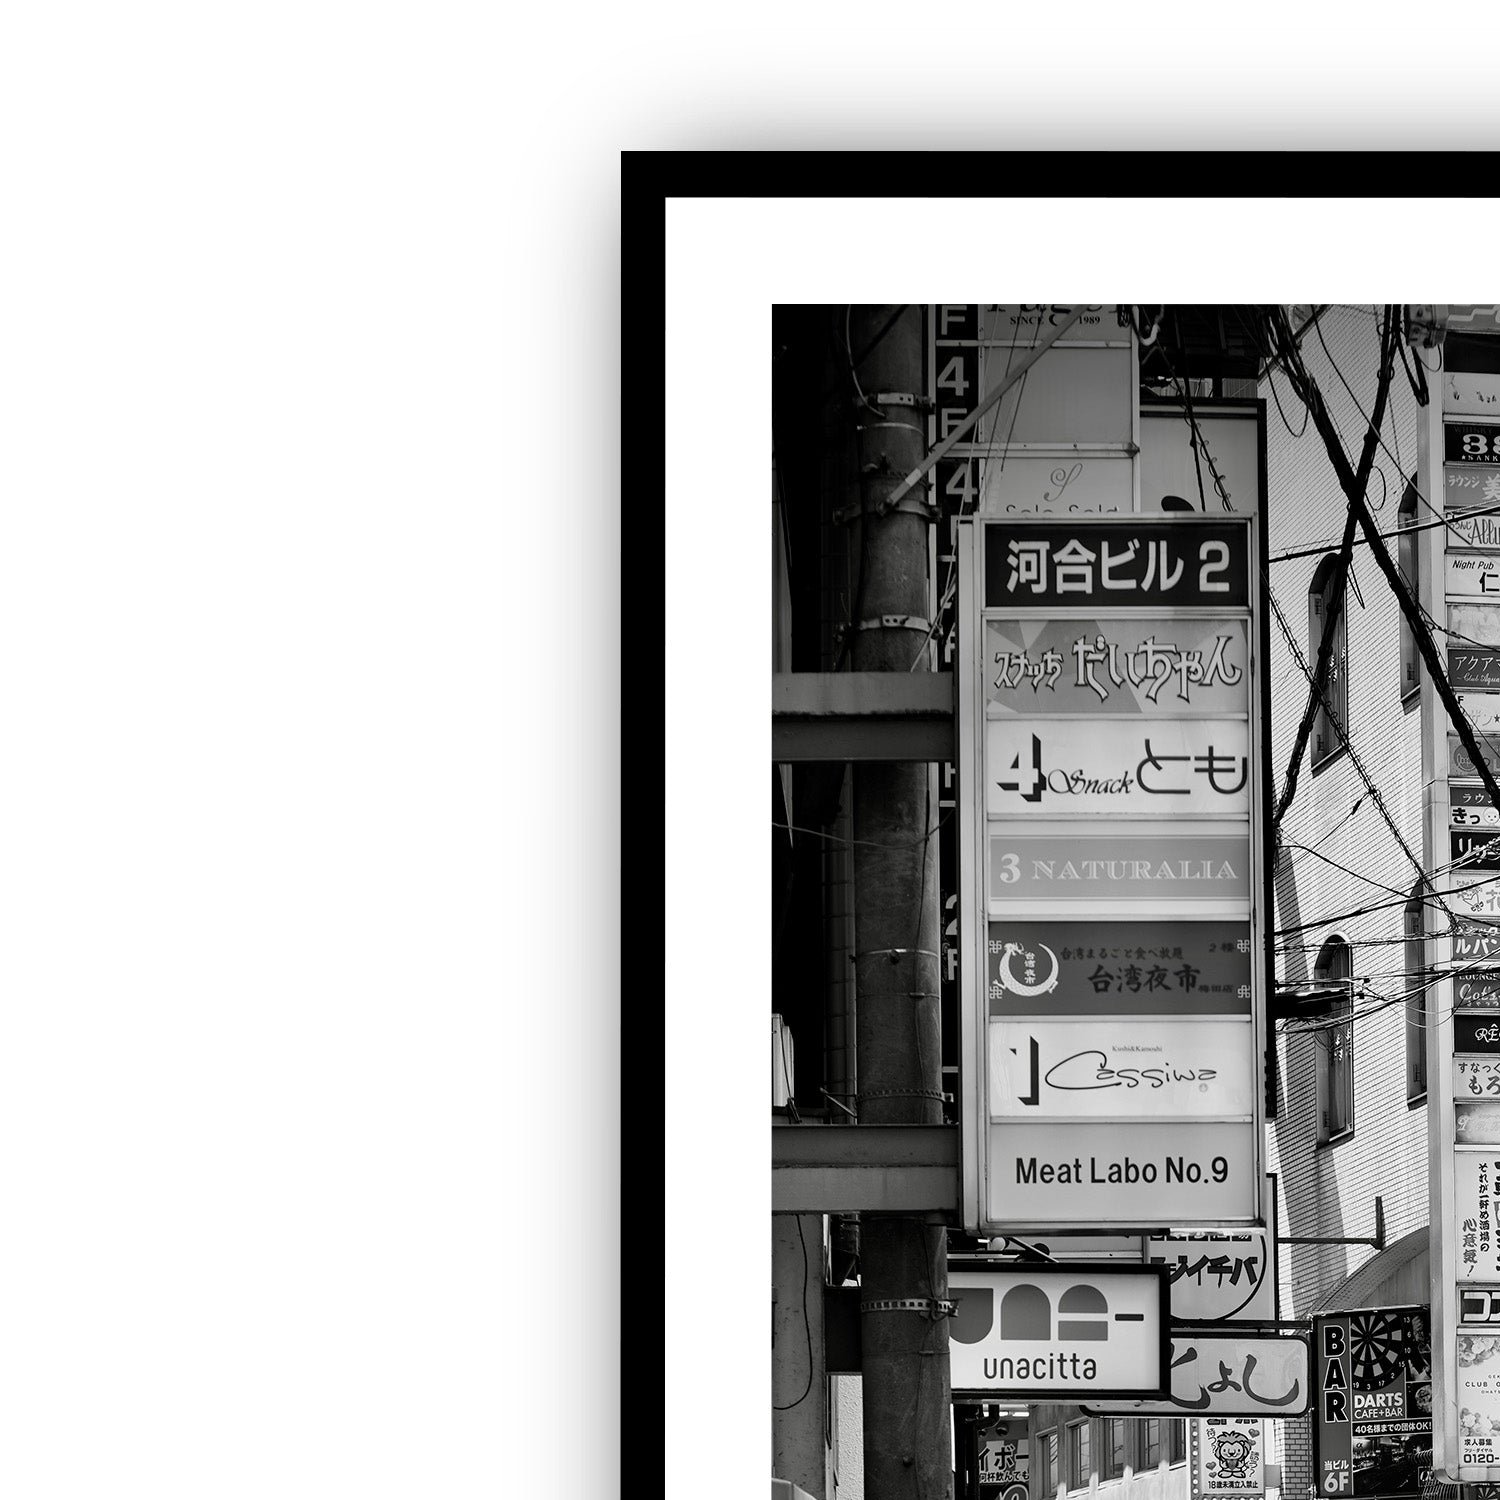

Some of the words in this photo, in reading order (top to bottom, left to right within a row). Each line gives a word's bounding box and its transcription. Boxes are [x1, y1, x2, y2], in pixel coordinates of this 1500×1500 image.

[1010, 316, 1044, 325] SINCE
[1078, 315, 1101, 325] 1989
[1448, 475, 1480, 489] ラウンジ
[1006, 538, 1185, 594] 河合ビル
[1199, 540, 1231, 593] 2
[1452, 560, 1476, 570] Night
[1477, 561, 1495, 570] Pub
[1478, 571, 1500, 594] 仁
[1071, 634, 1243, 705] だいちゃん
[996, 732, 1047, 802] 4
[1047, 769, 1135, 795] Snack
[1136, 738, 1248, 795] とも
[1000, 852, 1021, 883] 3
[1031, 858, 1240, 881] NATURALIA
[1087, 963, 1201, 993] 台湾夜市
[1009, 1035, 1040, 1106] 1
[1016, 1157, 1083, 1184] Meat
[1091, 1157, 1158, 1184] Labo
[1166, 1156, 1229, 1184] No.9
[1478, 1162, 1490, 1252] それが一軒め酒場の
[983, 1353, 1098, 1380] unacitta
[1323, 1324, 1349, 1424] BAR
[1354, 1392, 1404, 1409] DARTS
[1354, 1407, 1404, 1420] CAFE+BAR
[1354, 1421, 1433, 1435] 40名様までの団体OK!
[1464, 1438, 1493, 1447] 求人募集
[1323, 1459, 1350, 1471] 当ビル
[1207, 1480, 1259, 1489] 18歳未満立入禁止
[1323, 1471, 1350, 1493] 6F
